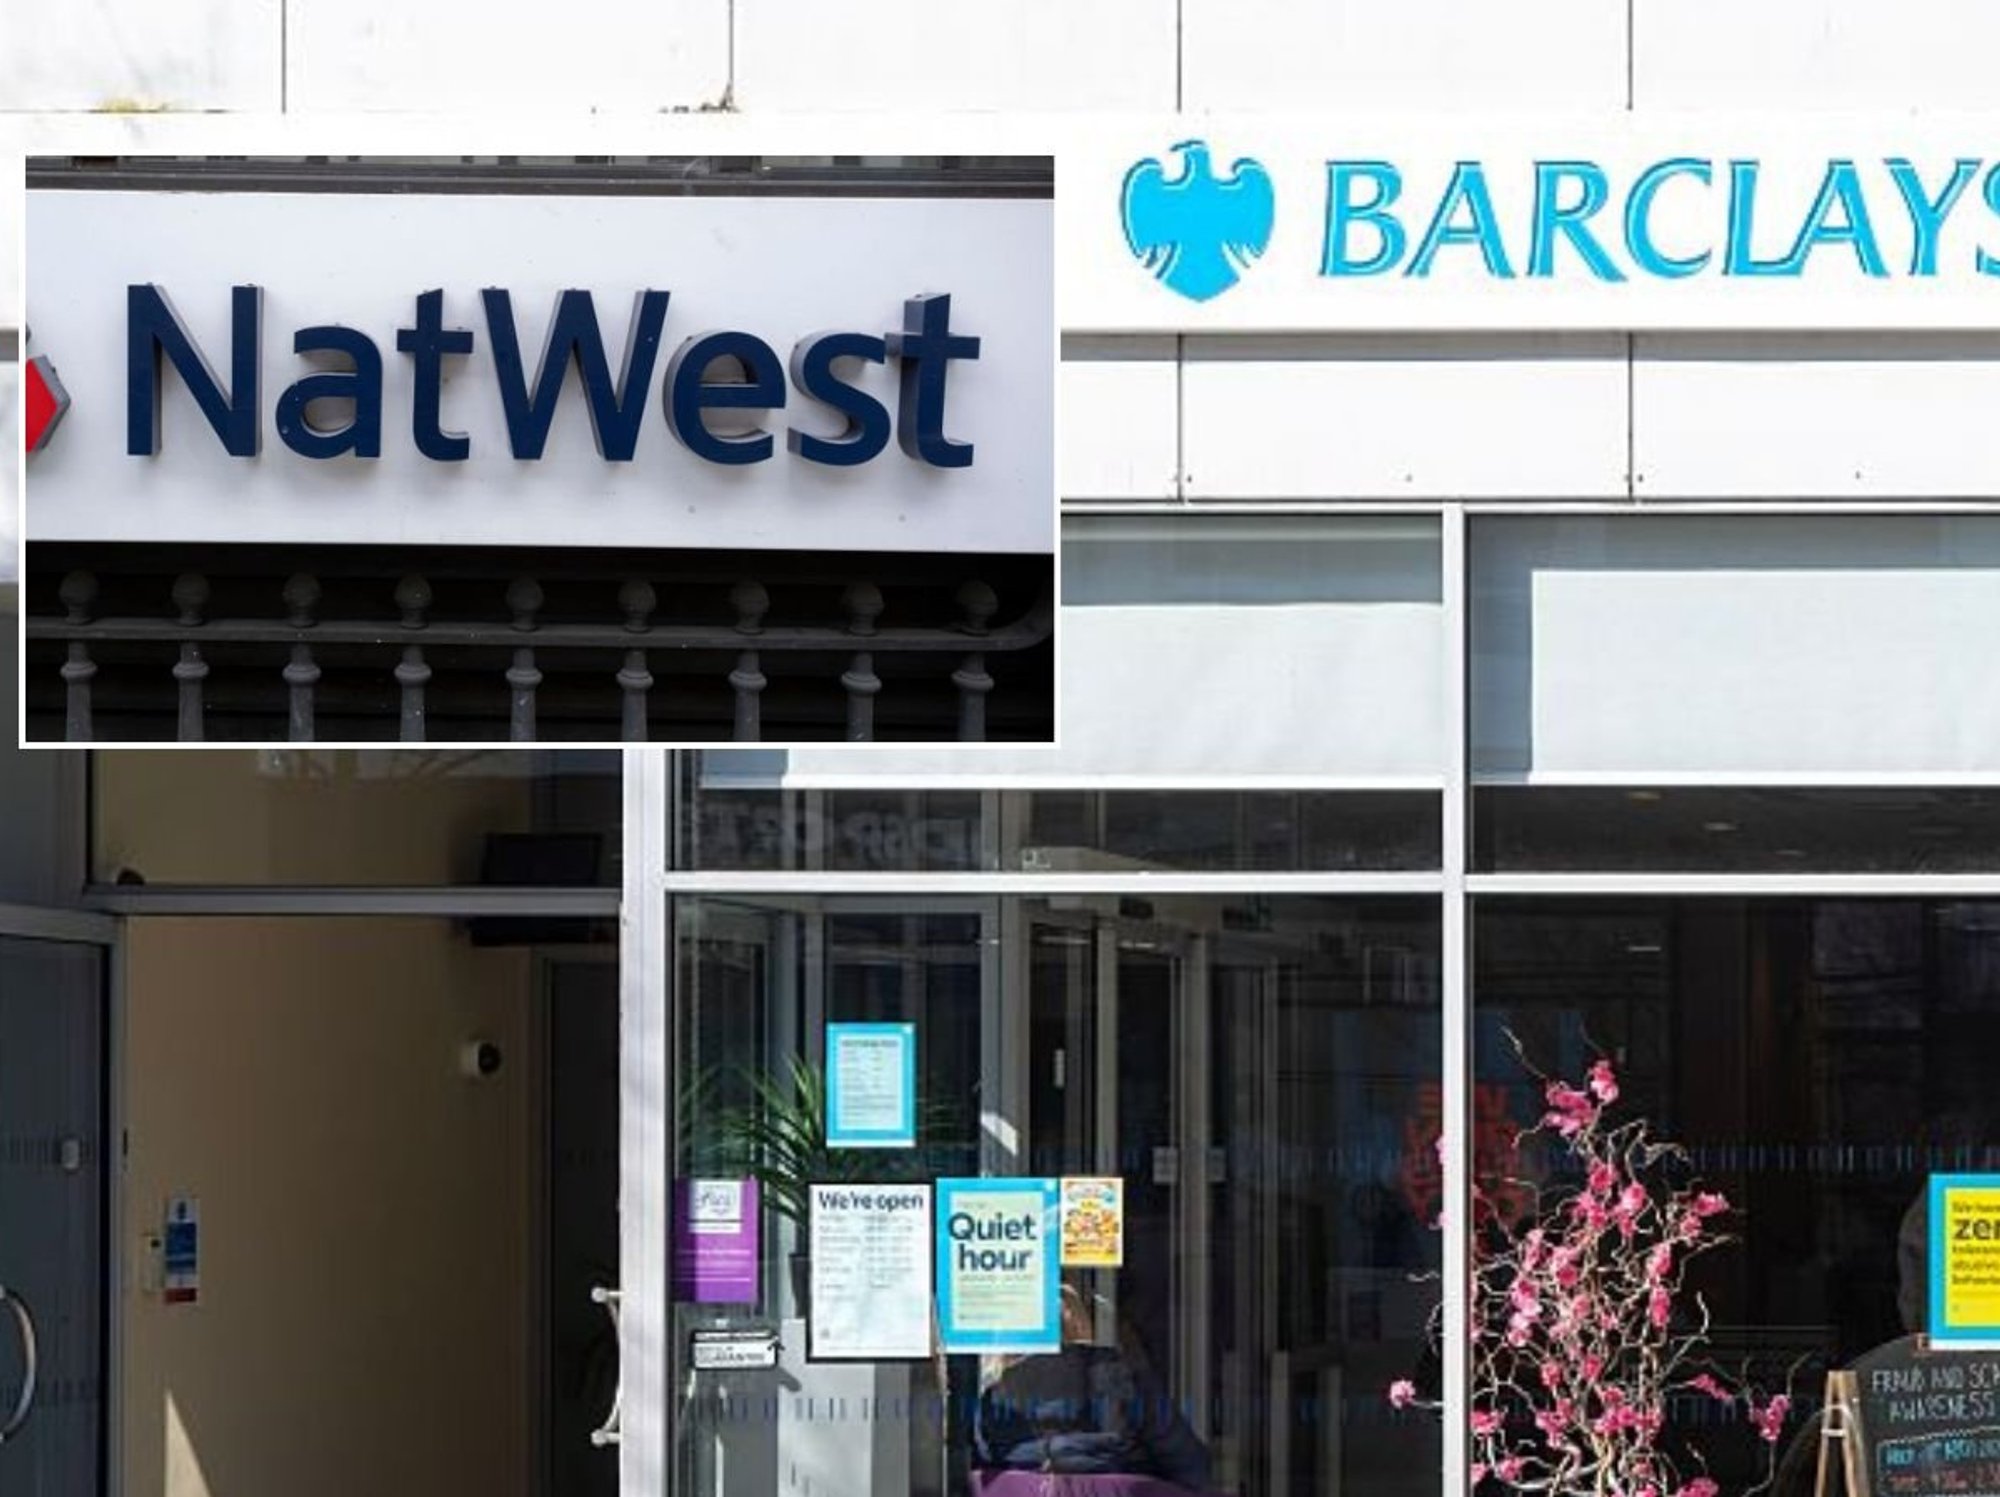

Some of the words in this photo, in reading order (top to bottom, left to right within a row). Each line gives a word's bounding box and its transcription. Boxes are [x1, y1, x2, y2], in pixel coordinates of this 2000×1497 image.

[126, 282, 981, 468] NatWest
[818, 1191, 872, 1210] We're
[876, 1194, 924, 1212] open
[947, 1212, 1037, 1241] Quiet
[958, 1244, 1033, 1271] hour
[1930, 1365, 1964, 1390] AND
